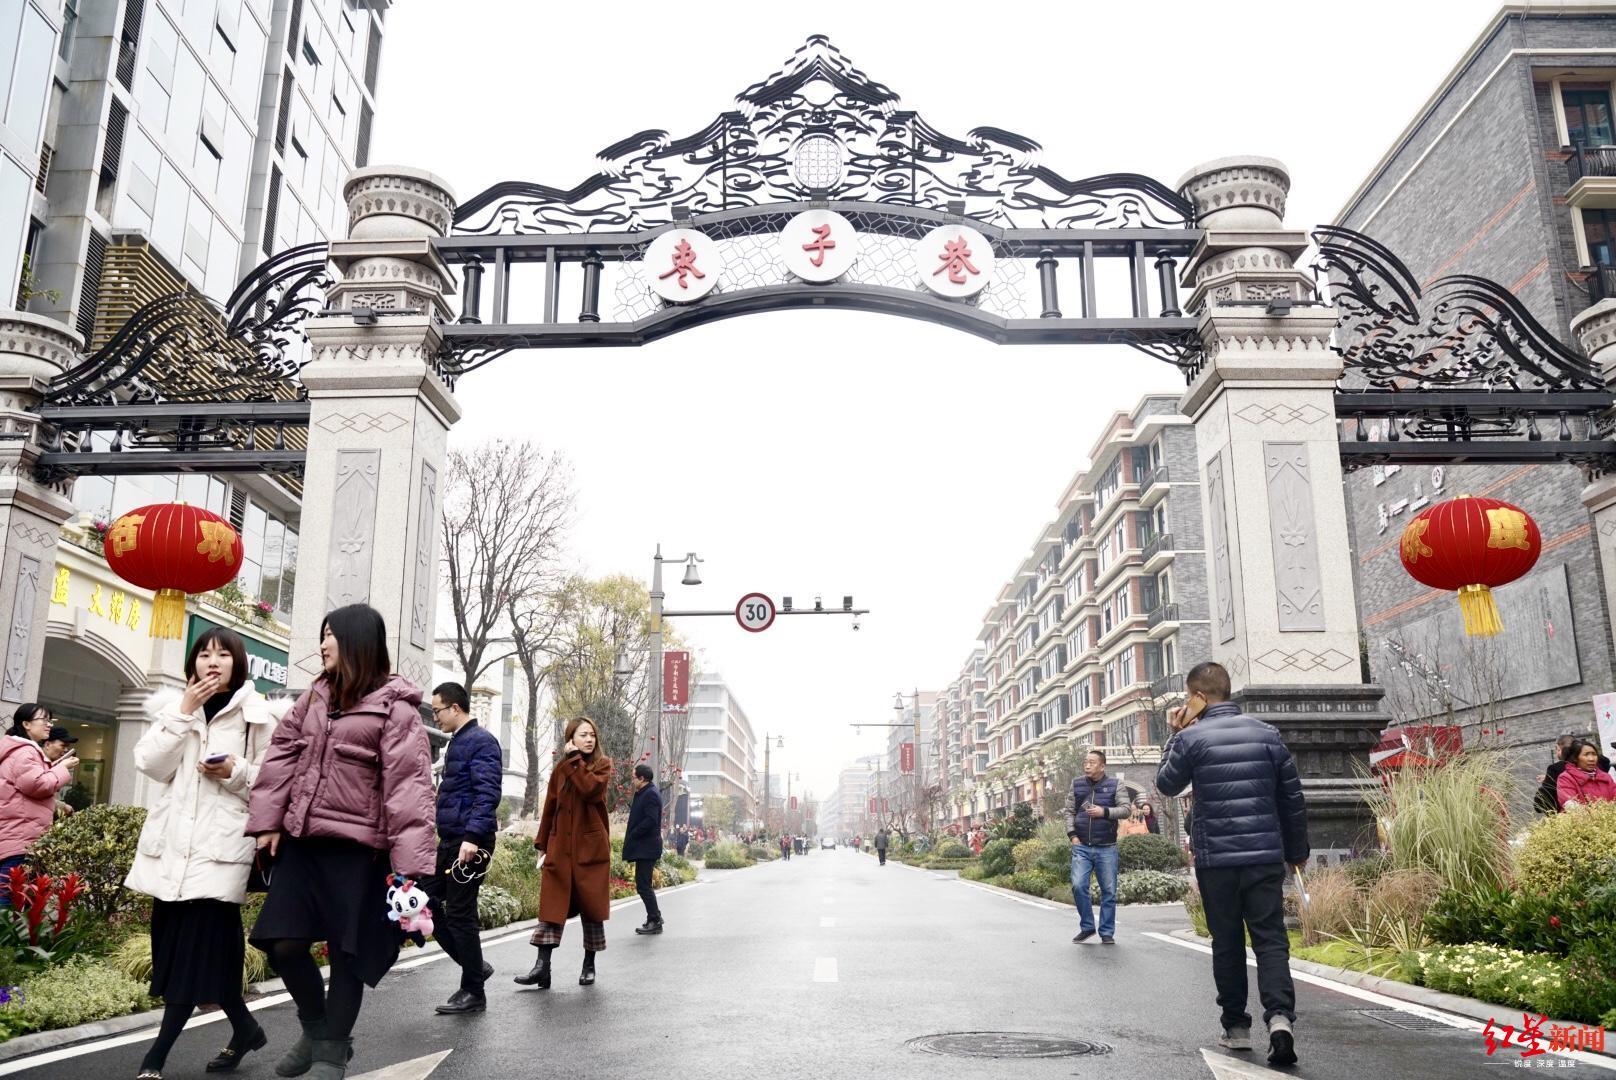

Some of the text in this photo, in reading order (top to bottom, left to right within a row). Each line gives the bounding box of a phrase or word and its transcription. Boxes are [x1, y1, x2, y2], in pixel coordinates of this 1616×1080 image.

[659, 223, 980, 288] 枣子巷
[746, 603, 767, 621] 30
